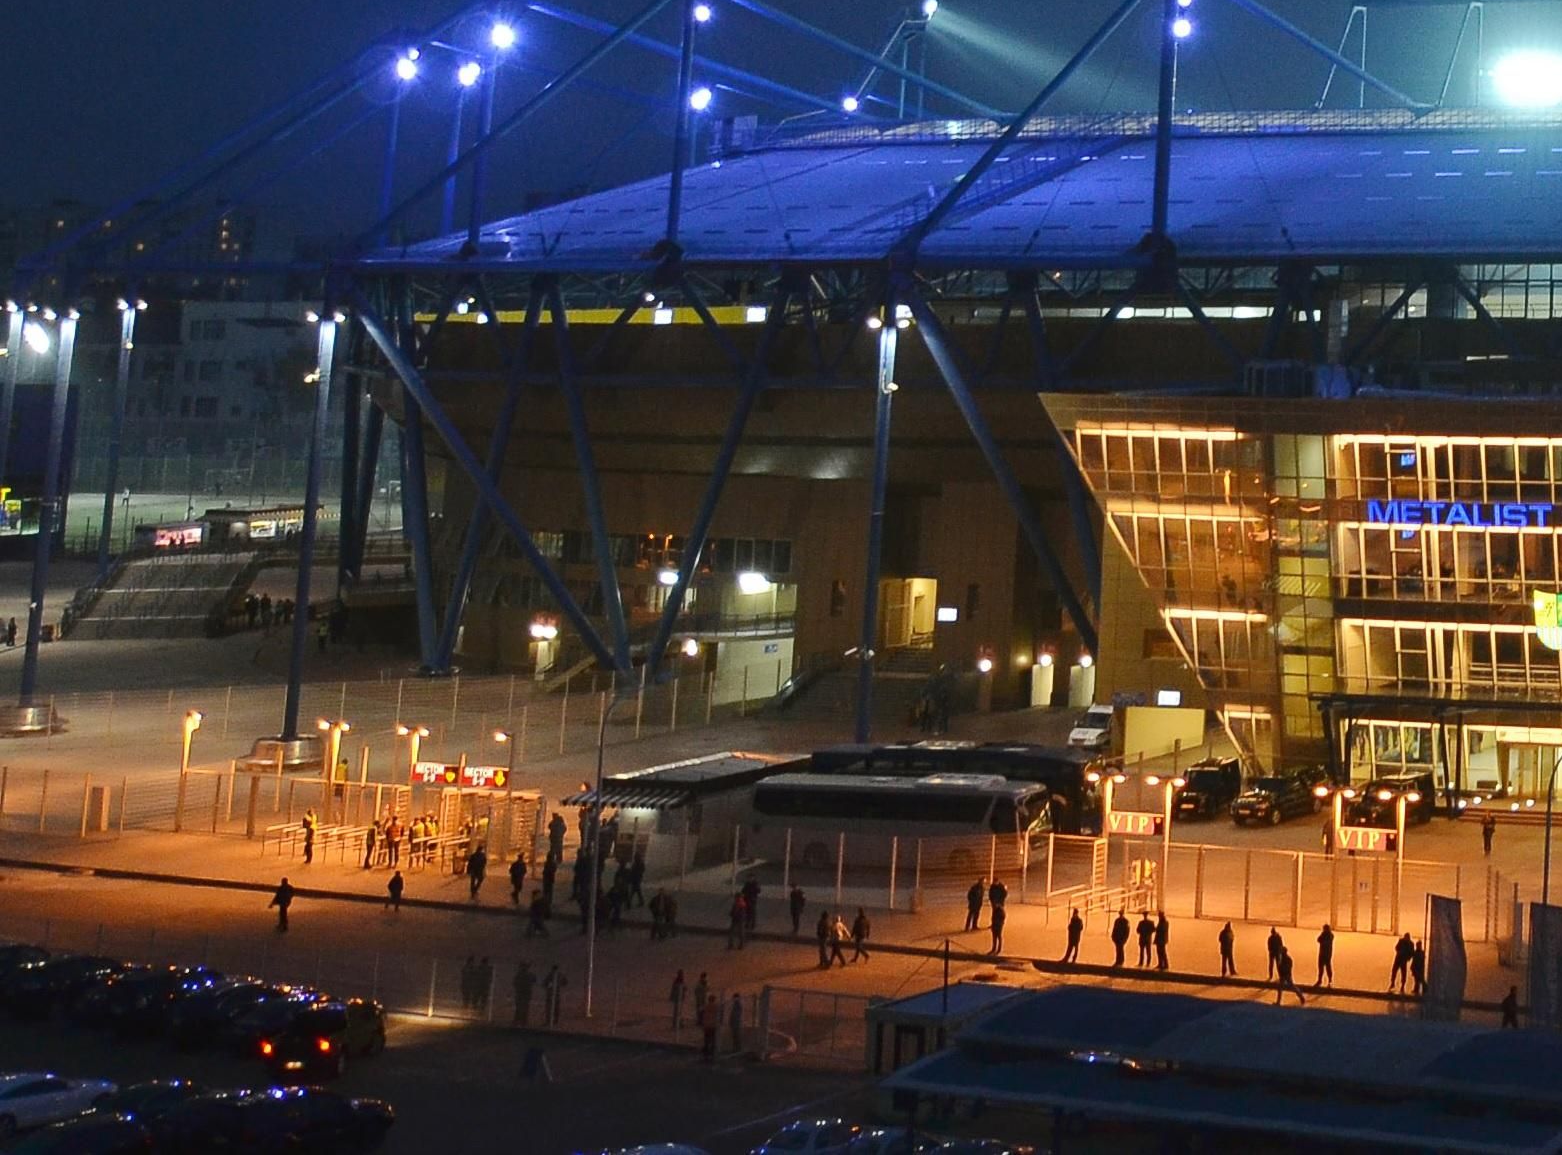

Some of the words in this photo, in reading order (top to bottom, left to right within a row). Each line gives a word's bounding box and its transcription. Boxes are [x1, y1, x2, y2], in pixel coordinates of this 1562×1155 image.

[1367, 500, 1552, 528] METALIST
[1109, 814, 1149, 833] VIP
[1338, 829, 1380, 850] VIP
